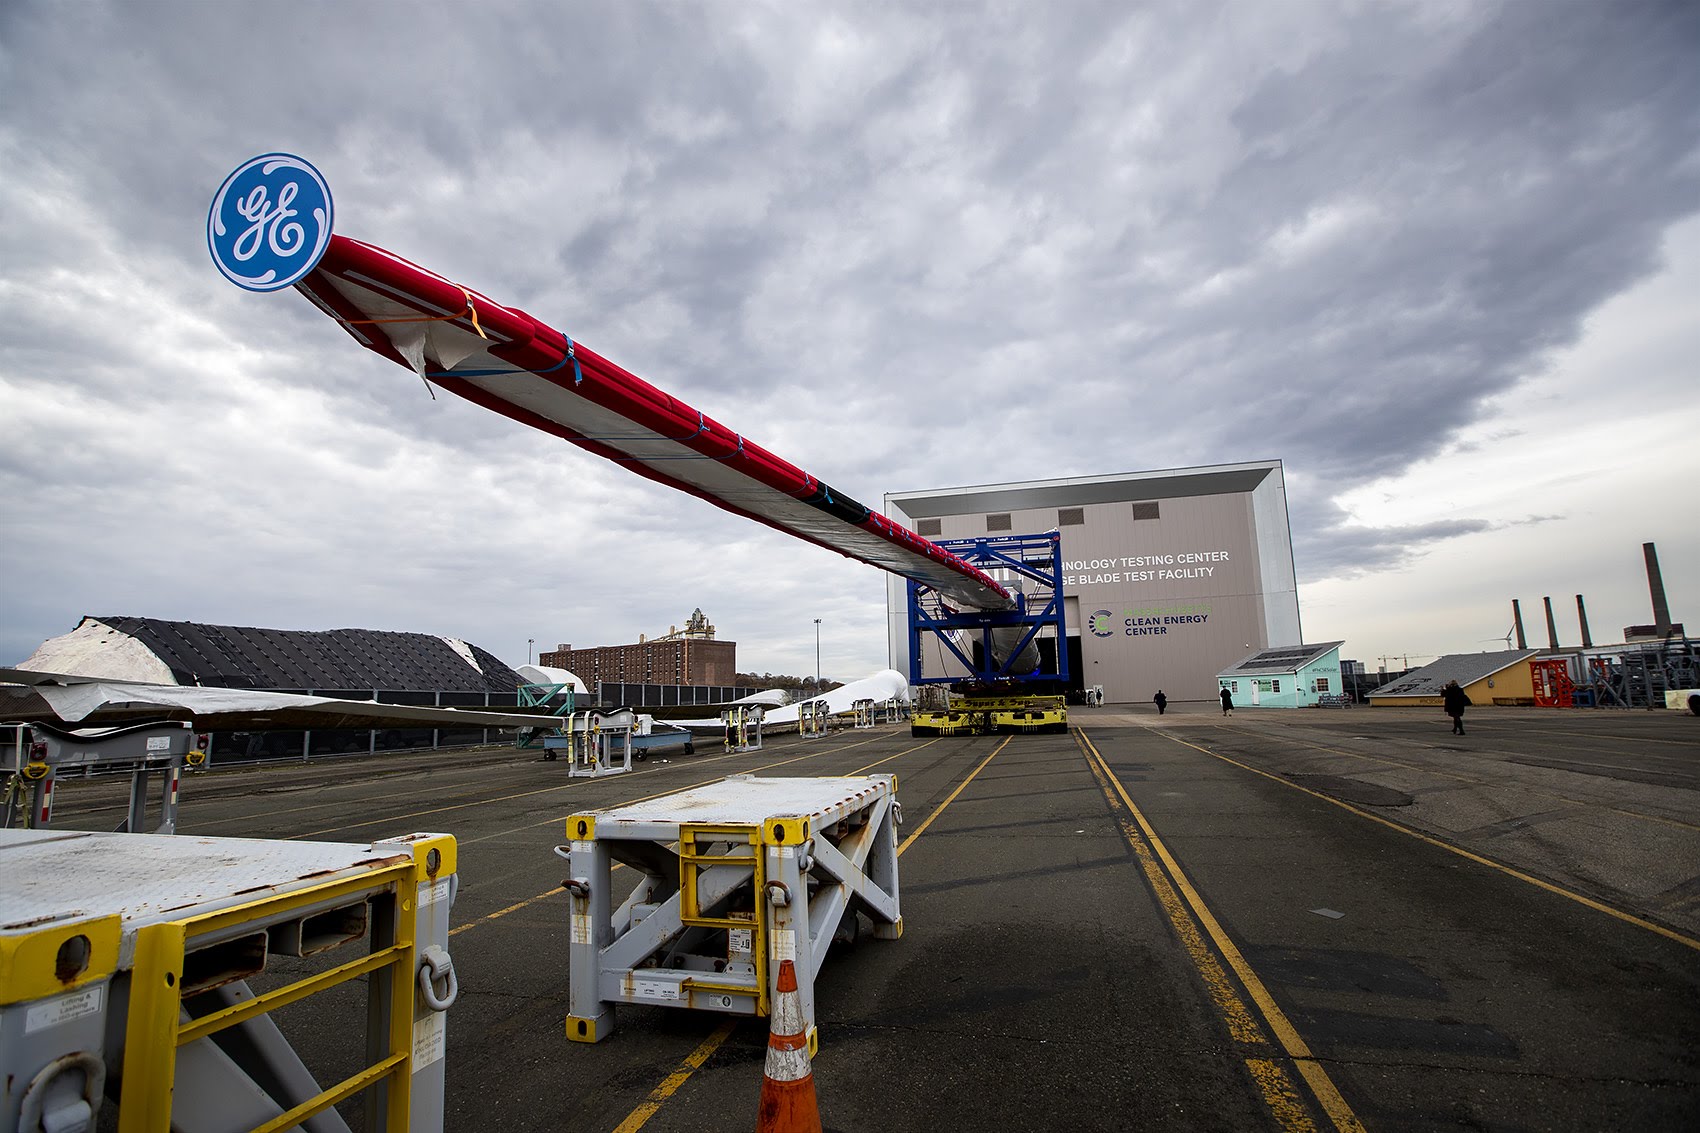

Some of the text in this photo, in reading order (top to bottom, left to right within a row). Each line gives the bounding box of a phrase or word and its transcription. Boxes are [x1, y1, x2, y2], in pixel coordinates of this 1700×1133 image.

[233, 181, 304, 262] GE
[1120, 555, 1174, 567] TESTING
[1177, 551, 1230, 564] CENTER
[1079, 573, 1120, 585] BLADE
[1123, 570, 1155, 582] TEST
[1158, 567, 1214, 580] FACILITY
[1124, 614, 1208, 627] CLEAN ENERGY
[1125, 626, 1167, 637] CENTER
